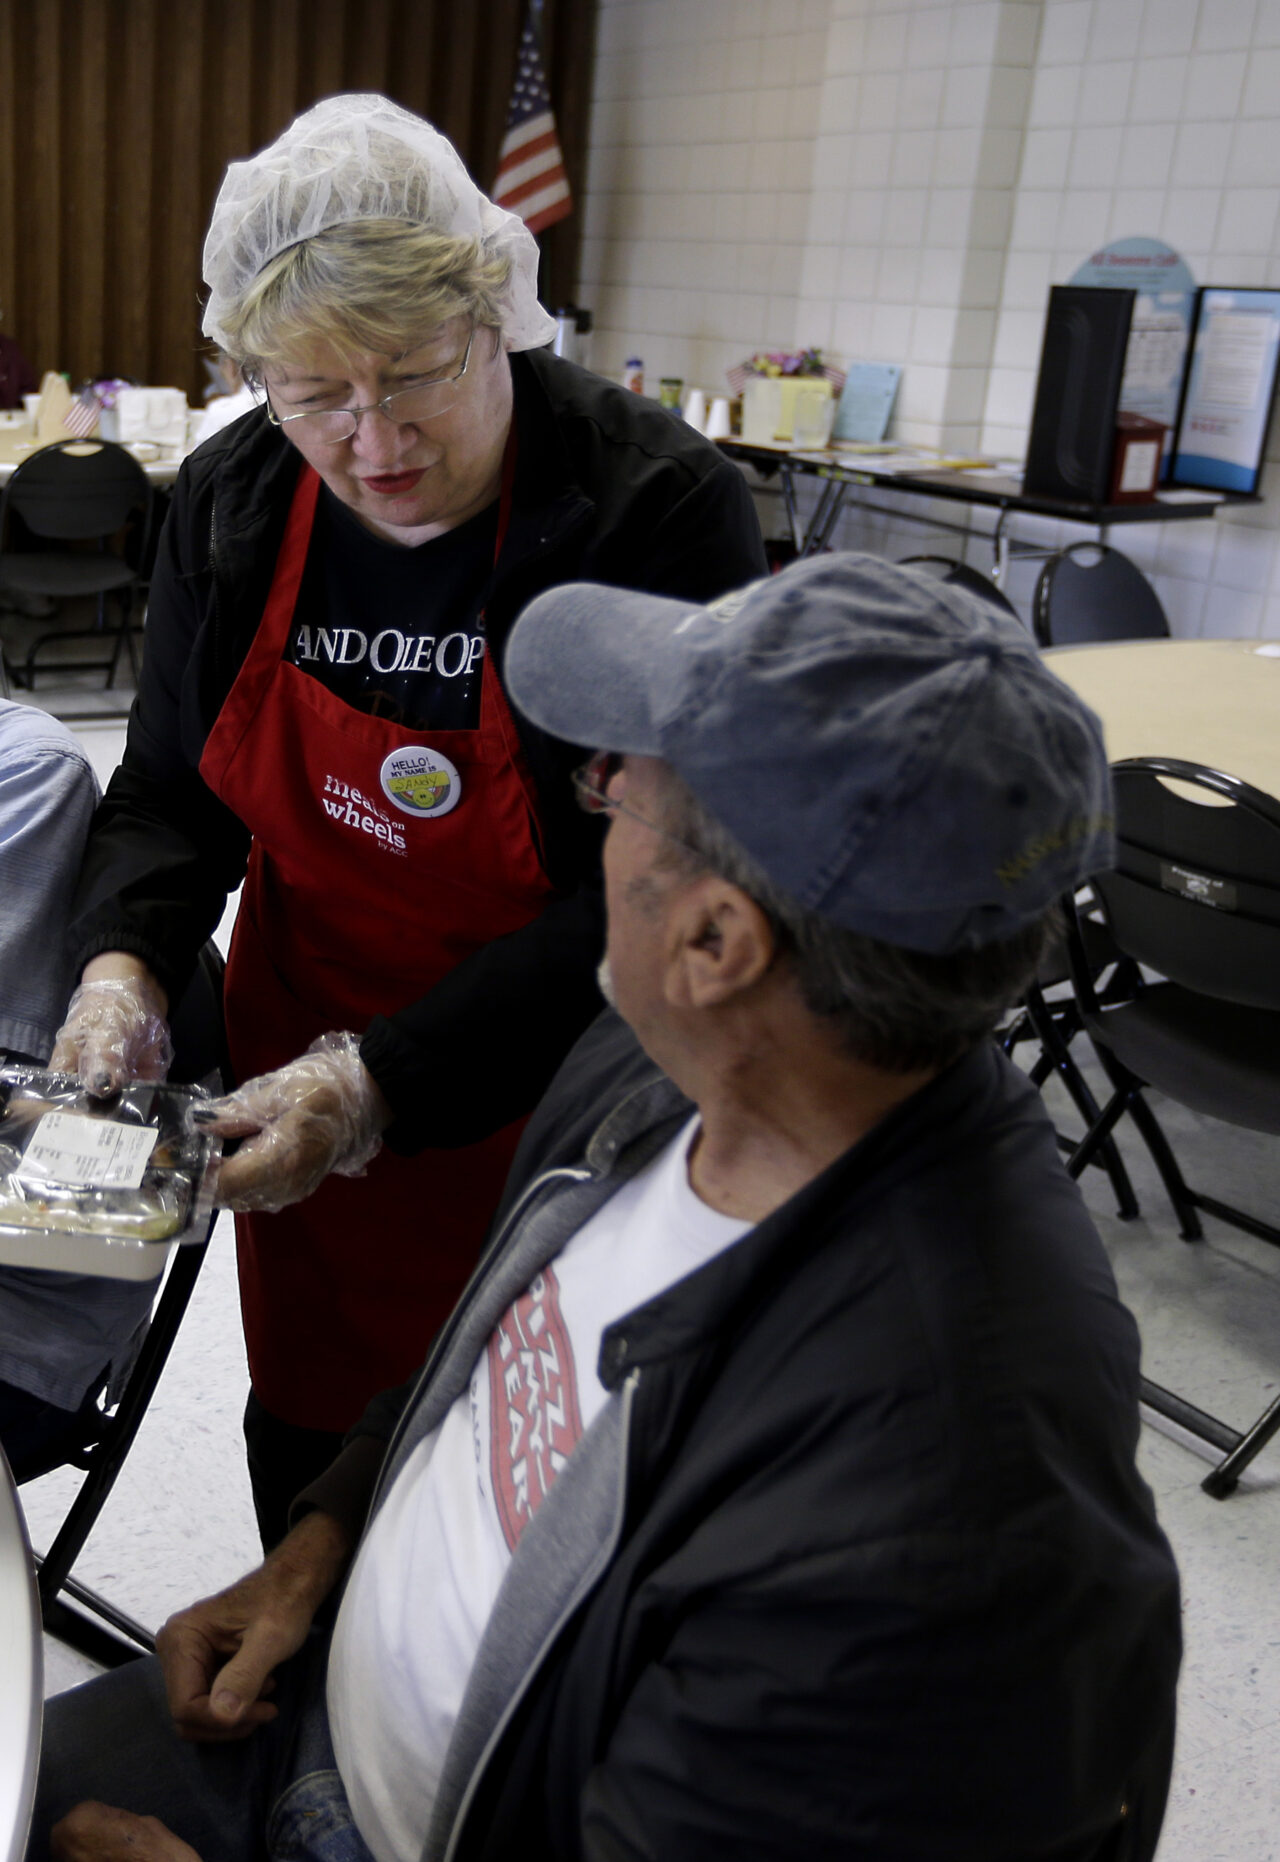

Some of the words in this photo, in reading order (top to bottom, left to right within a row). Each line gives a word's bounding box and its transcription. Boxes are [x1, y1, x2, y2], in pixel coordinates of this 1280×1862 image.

[293, 623, 368, 665] AND
[369, 629, 436, 674] OLE
[405, 767, 427, 776] NAME
[322, 798, 407, 850] wheels
[391, 821, 406, 831] on
[498, 1324, 533, 1521] HEAR
